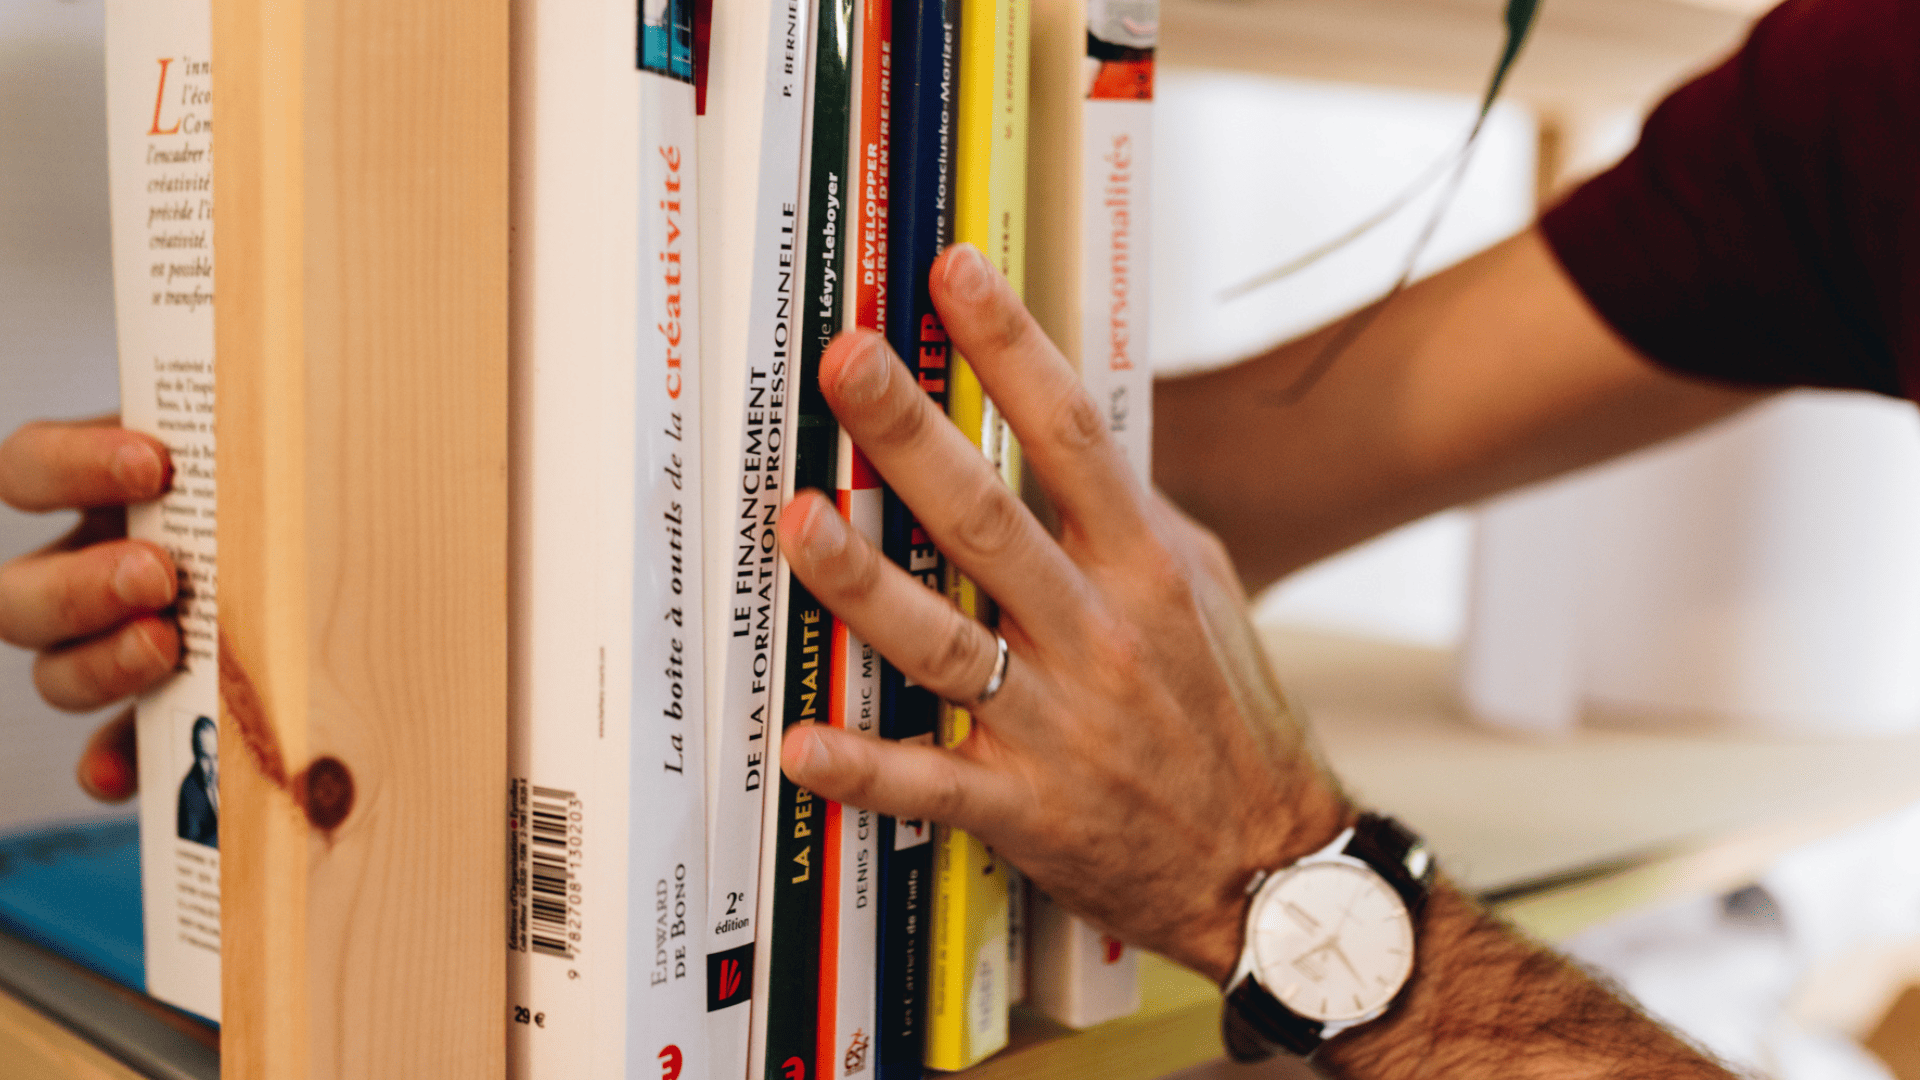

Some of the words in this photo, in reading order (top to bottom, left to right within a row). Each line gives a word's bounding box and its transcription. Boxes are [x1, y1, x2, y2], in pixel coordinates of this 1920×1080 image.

[784, 0, 799, 75] BERNIE
[783, 84, 793, 98] P.
[879, 40, 890, 200] D'ENTREPRISE
[935, 21, 953, 210] Kosciusko-Morizet
[819, 171, 839, 318] Lévy-Leboyer
[862, 143, 878, 285] DÉVELOPPER
[657, 145, 682, 400] créativité
[1103, 134, 1135, 371] personnalités
[764, 202, 796, 490] PROFESSIONNELLE
[663, 411, 682, 442] la
[663, 453, 682, 491] de
[735, 366, 767, 595] FINANCEMENT
[663, 501, 683, 596] outils
[664, 606, 683, 628] à
[733, 605, 751, 638] LE
[751, 504, 777, 695] FORMATION
[663, 637, 683, 721] boîte
[856, 687, 873, 731] ÉRIC
[663, 733, 683, 775] La
[748, 704, 764, 741] LA
[793, 608, 820, 838] PERNALITÉ
[745, 751, 762, 792] DE
[570, 799, 583, 869] 130203
[792, 846, 811, 884] LA
[855, 850, 869, 910] DENIS
[569, 882, 582, 954] 782708
[714, 917, 750, 935] édition
[568, 970, 579, 980] 9
[514, 1005, 530, 1025] 29
